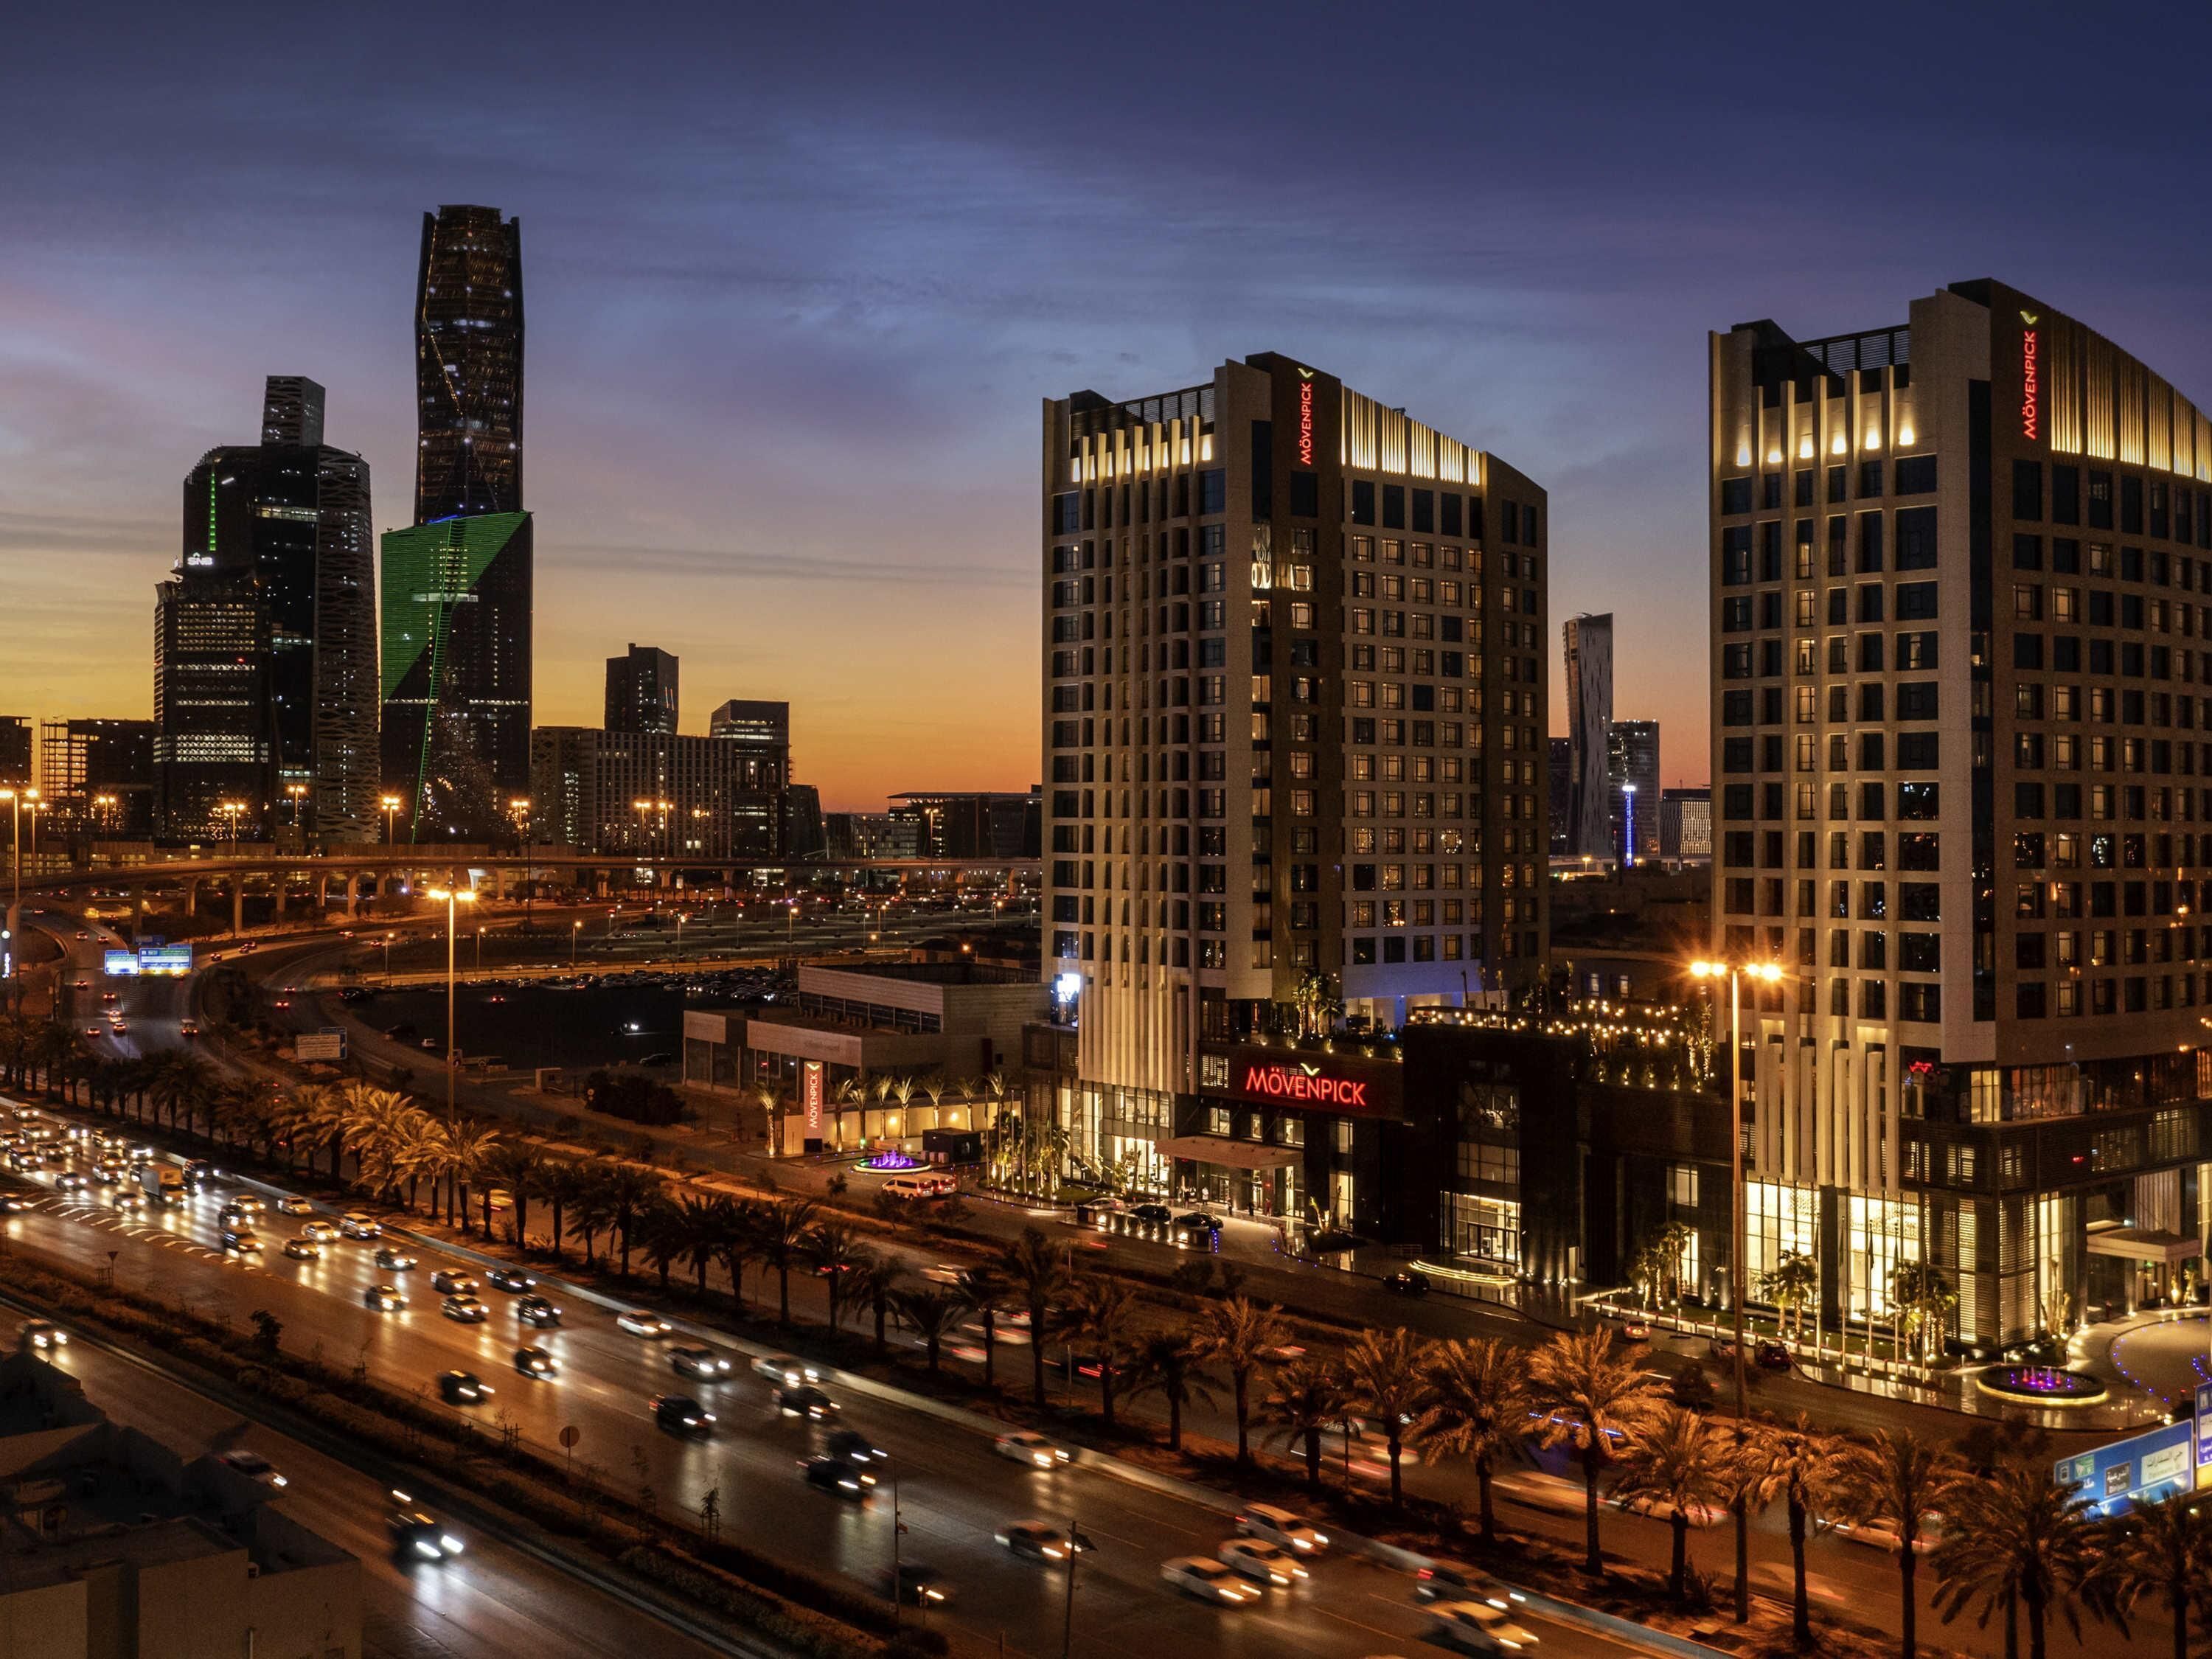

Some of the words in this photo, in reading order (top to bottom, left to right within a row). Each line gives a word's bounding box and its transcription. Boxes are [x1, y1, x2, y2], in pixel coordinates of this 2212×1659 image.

[1299, 383, 1312, 465] MÖVENPICK
[2023, 330, 2037, 439] MÖVENPICK
[1246, 1067, 1366, 1106] MÖVENPICK
